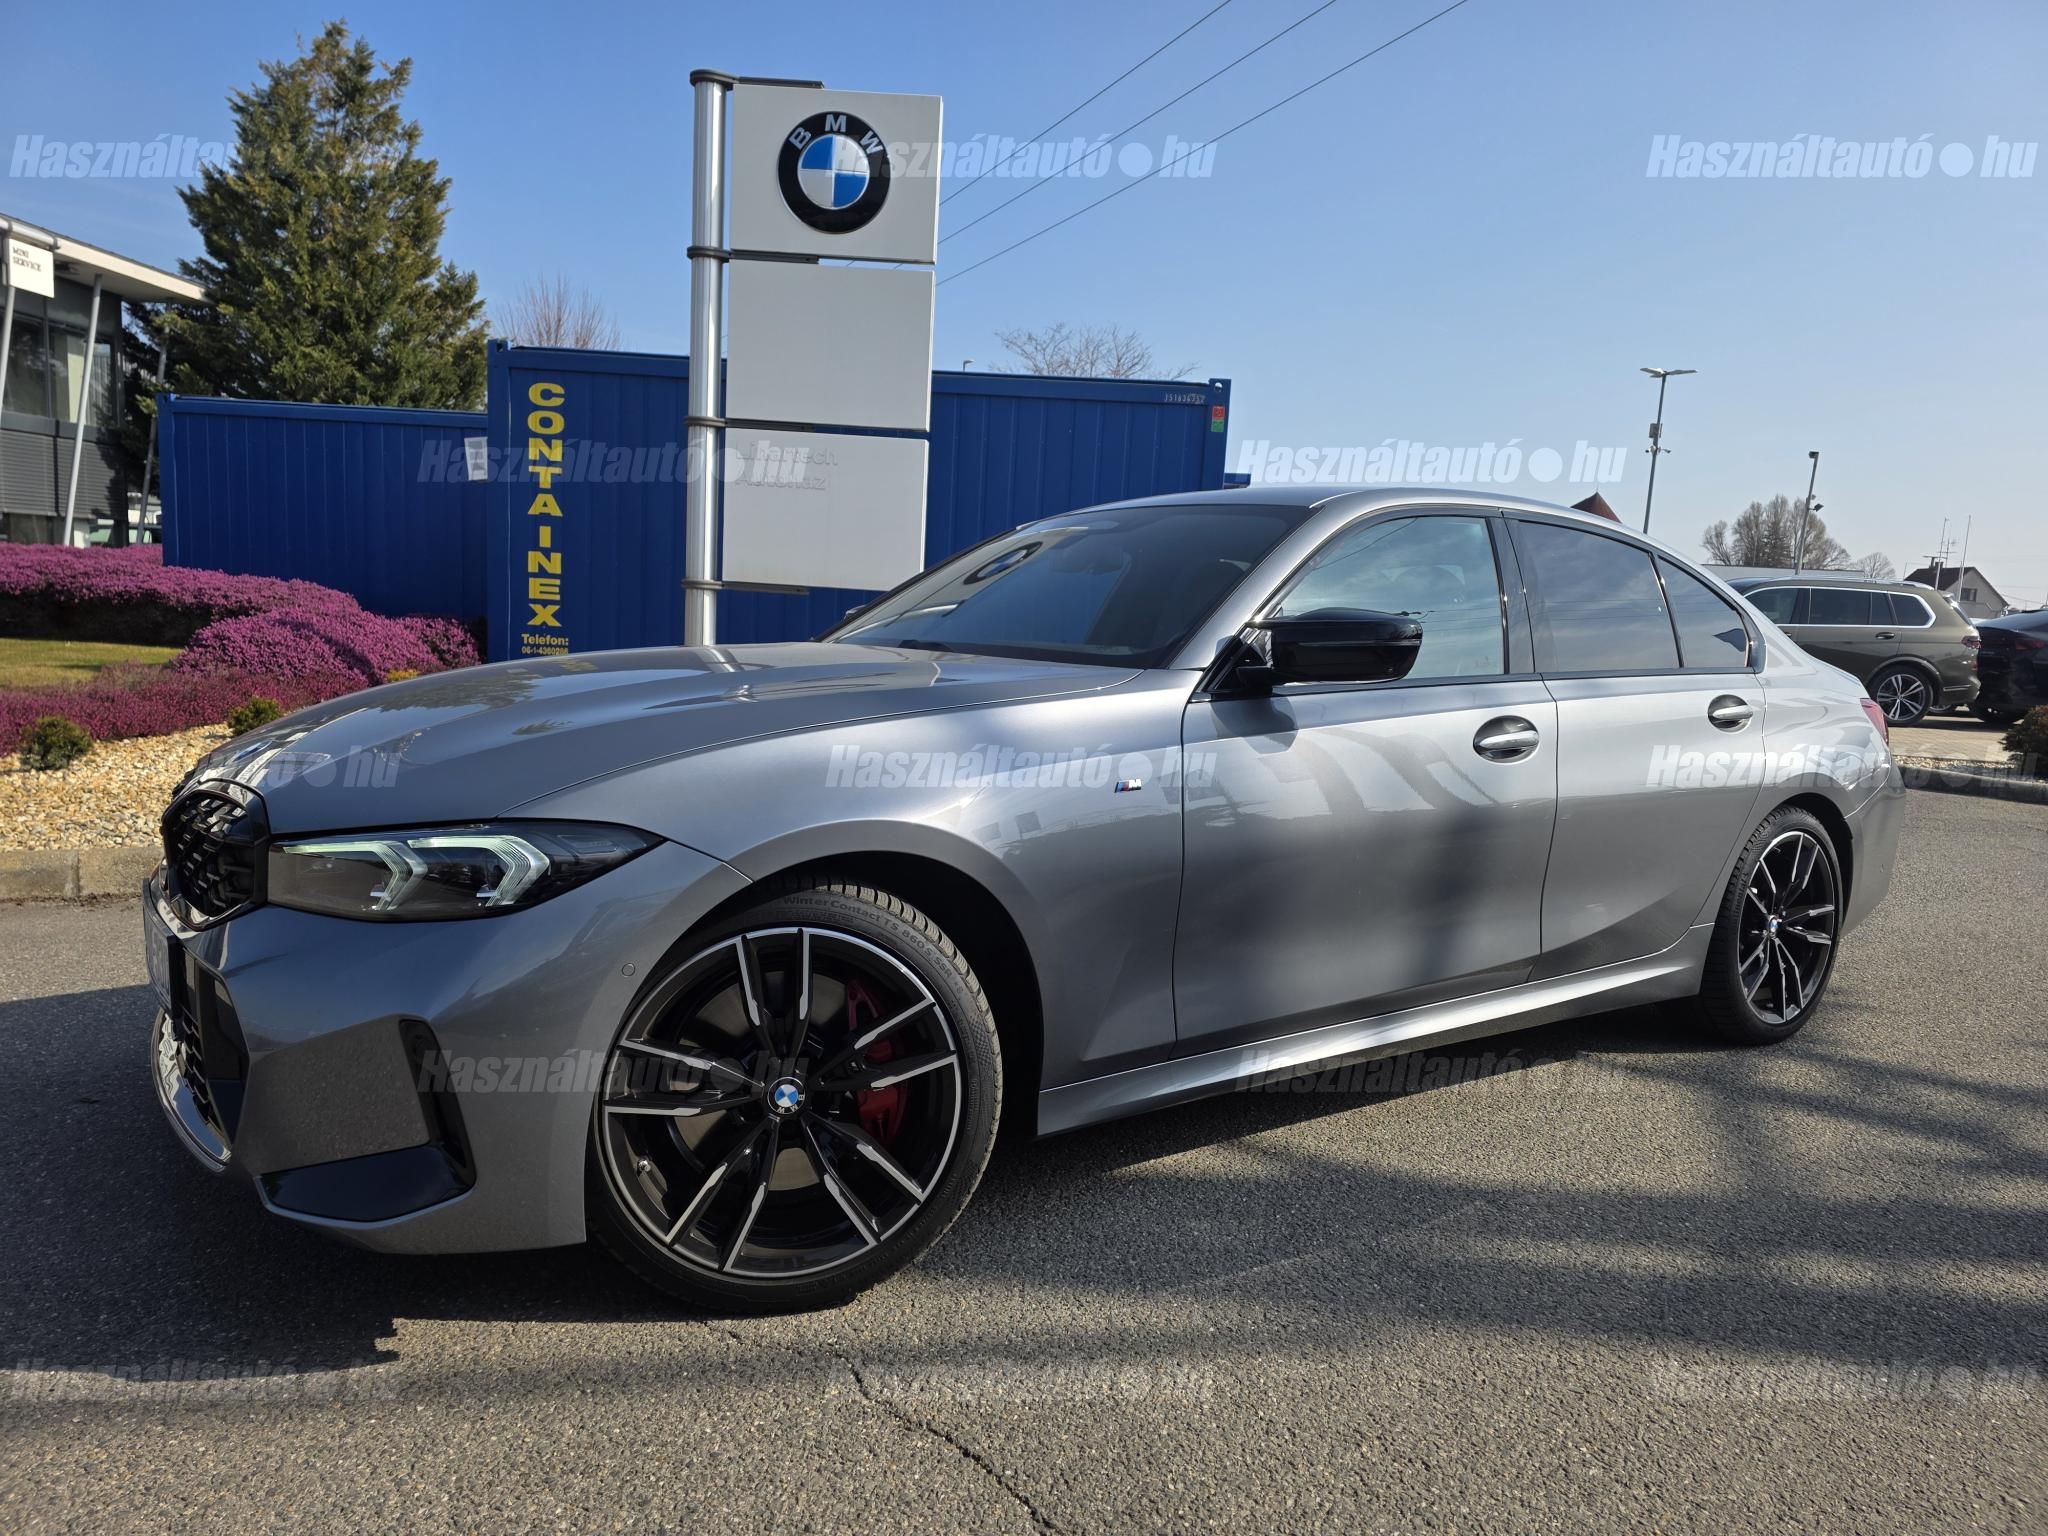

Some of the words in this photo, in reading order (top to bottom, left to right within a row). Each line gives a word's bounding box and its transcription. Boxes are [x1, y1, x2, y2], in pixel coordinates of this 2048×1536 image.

[789, 114, 884, 154] BMW
[527, 382, 565, 627] CONTAINEX
[521, 633, 569, 645] Telefon:
